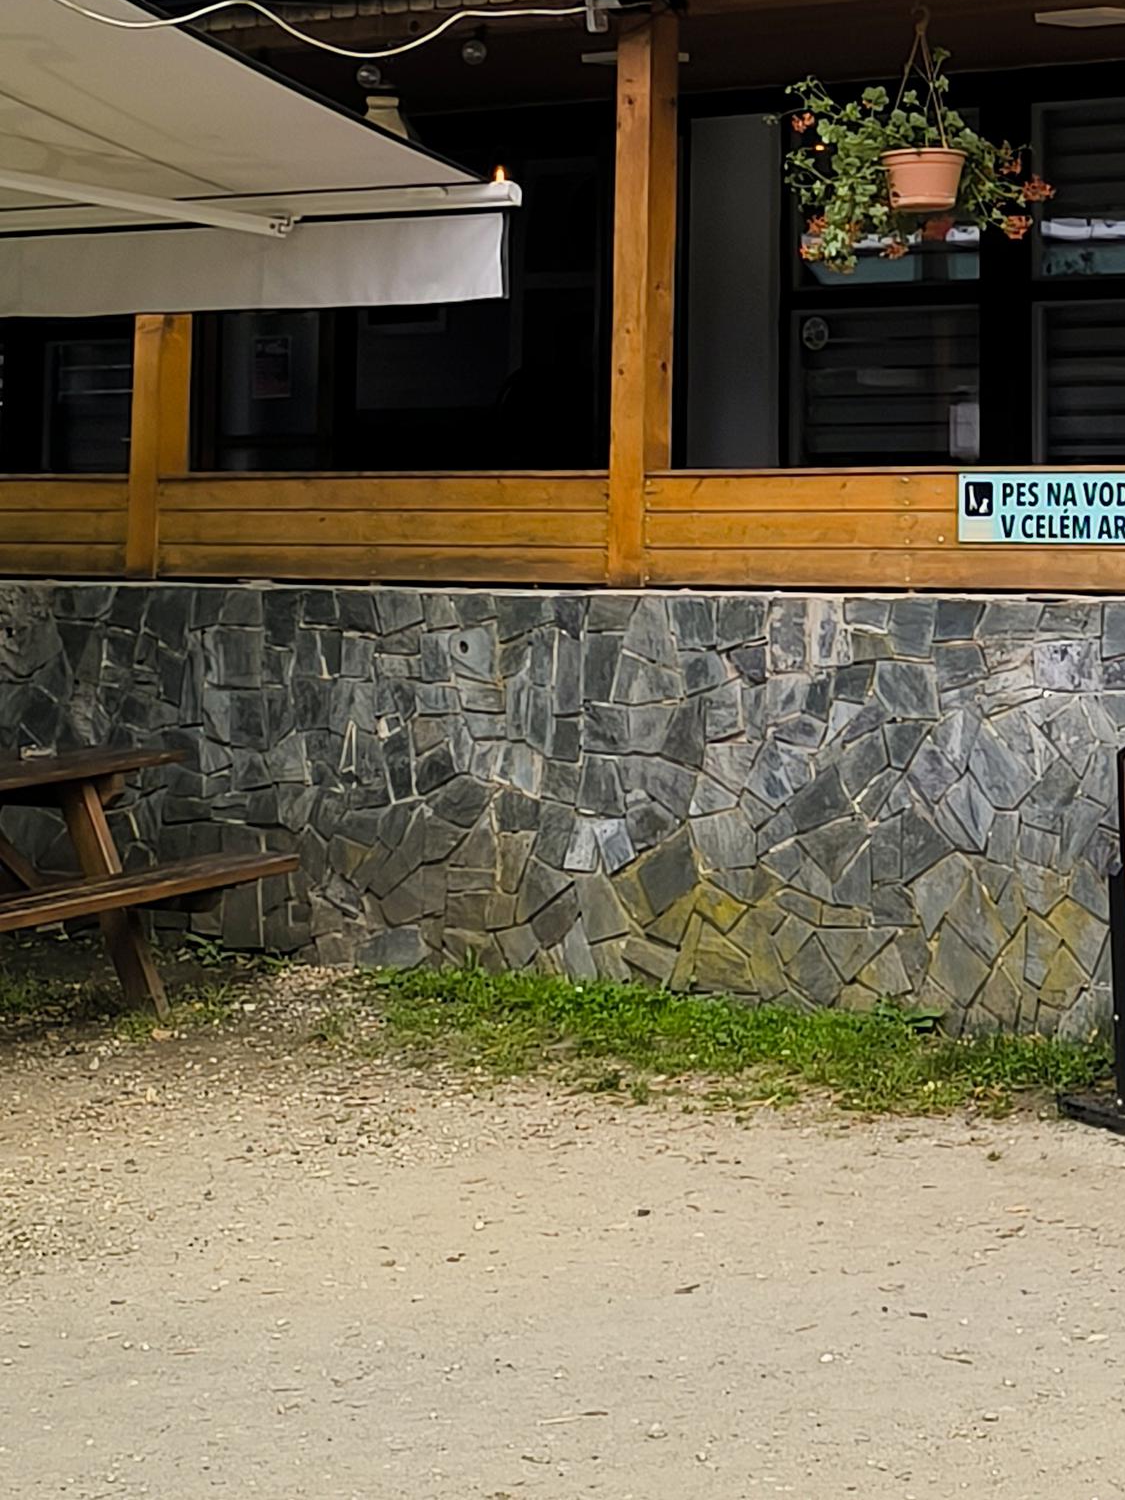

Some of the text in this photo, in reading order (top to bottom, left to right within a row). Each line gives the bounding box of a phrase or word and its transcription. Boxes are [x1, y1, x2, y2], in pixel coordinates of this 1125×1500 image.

[1001, 482, 1040, 507] PES
[1047, 482, 1078, 507] NA
[1000, 514, 1016, 539] V
[1021, 508, 1091, 539] CELÉM
